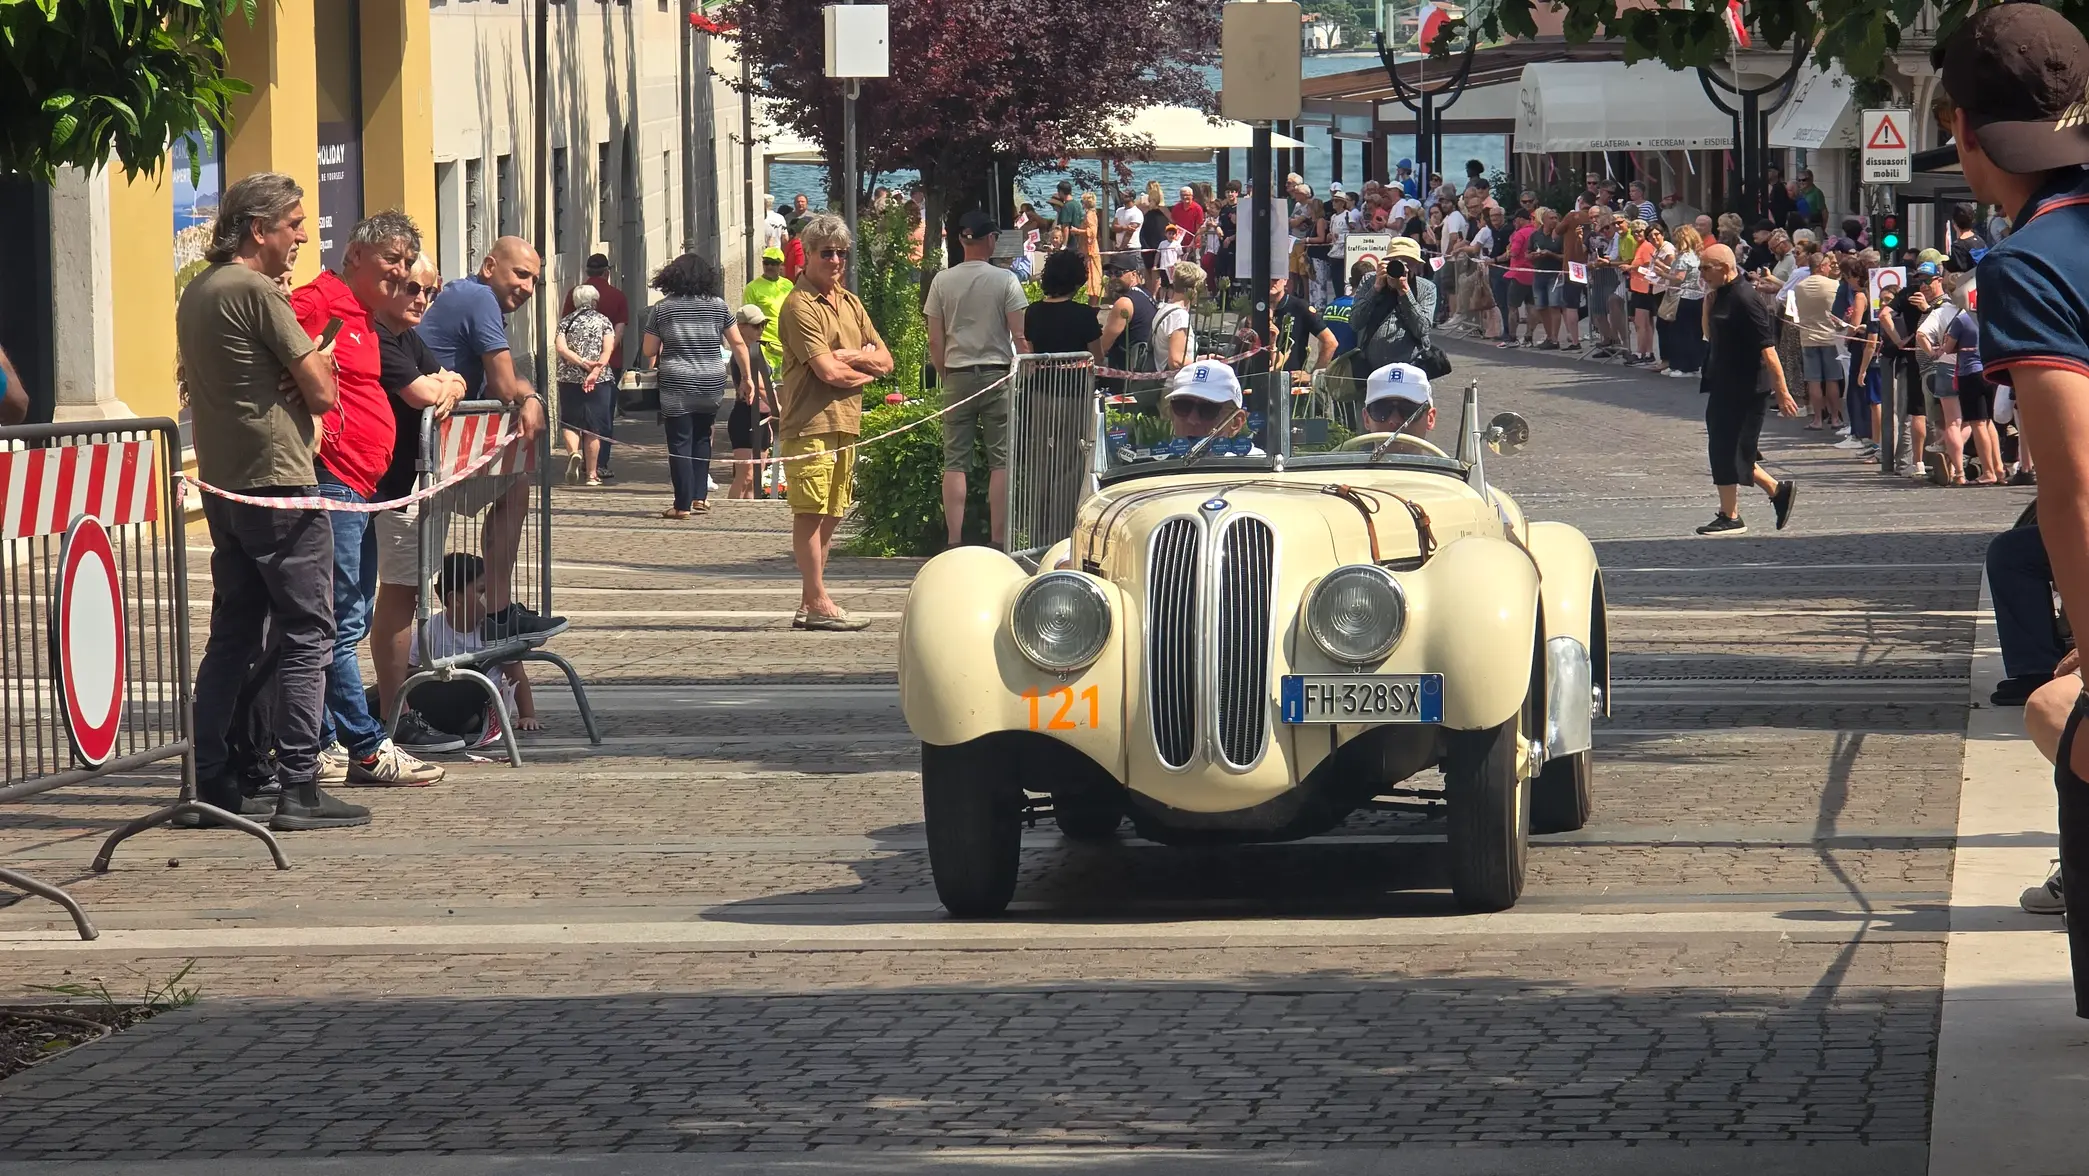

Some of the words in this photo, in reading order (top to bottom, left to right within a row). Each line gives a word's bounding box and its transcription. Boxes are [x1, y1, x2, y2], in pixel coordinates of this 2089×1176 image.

[1590, 140, 1630, 148] GELATERIA
[1649, 139, 1685, 147] ICECREAM
[1866, 157, 1907, 165] dissuasori
[1873, 169, 1900, 178] mobili
[1021, 683, 1098, 730] 121
